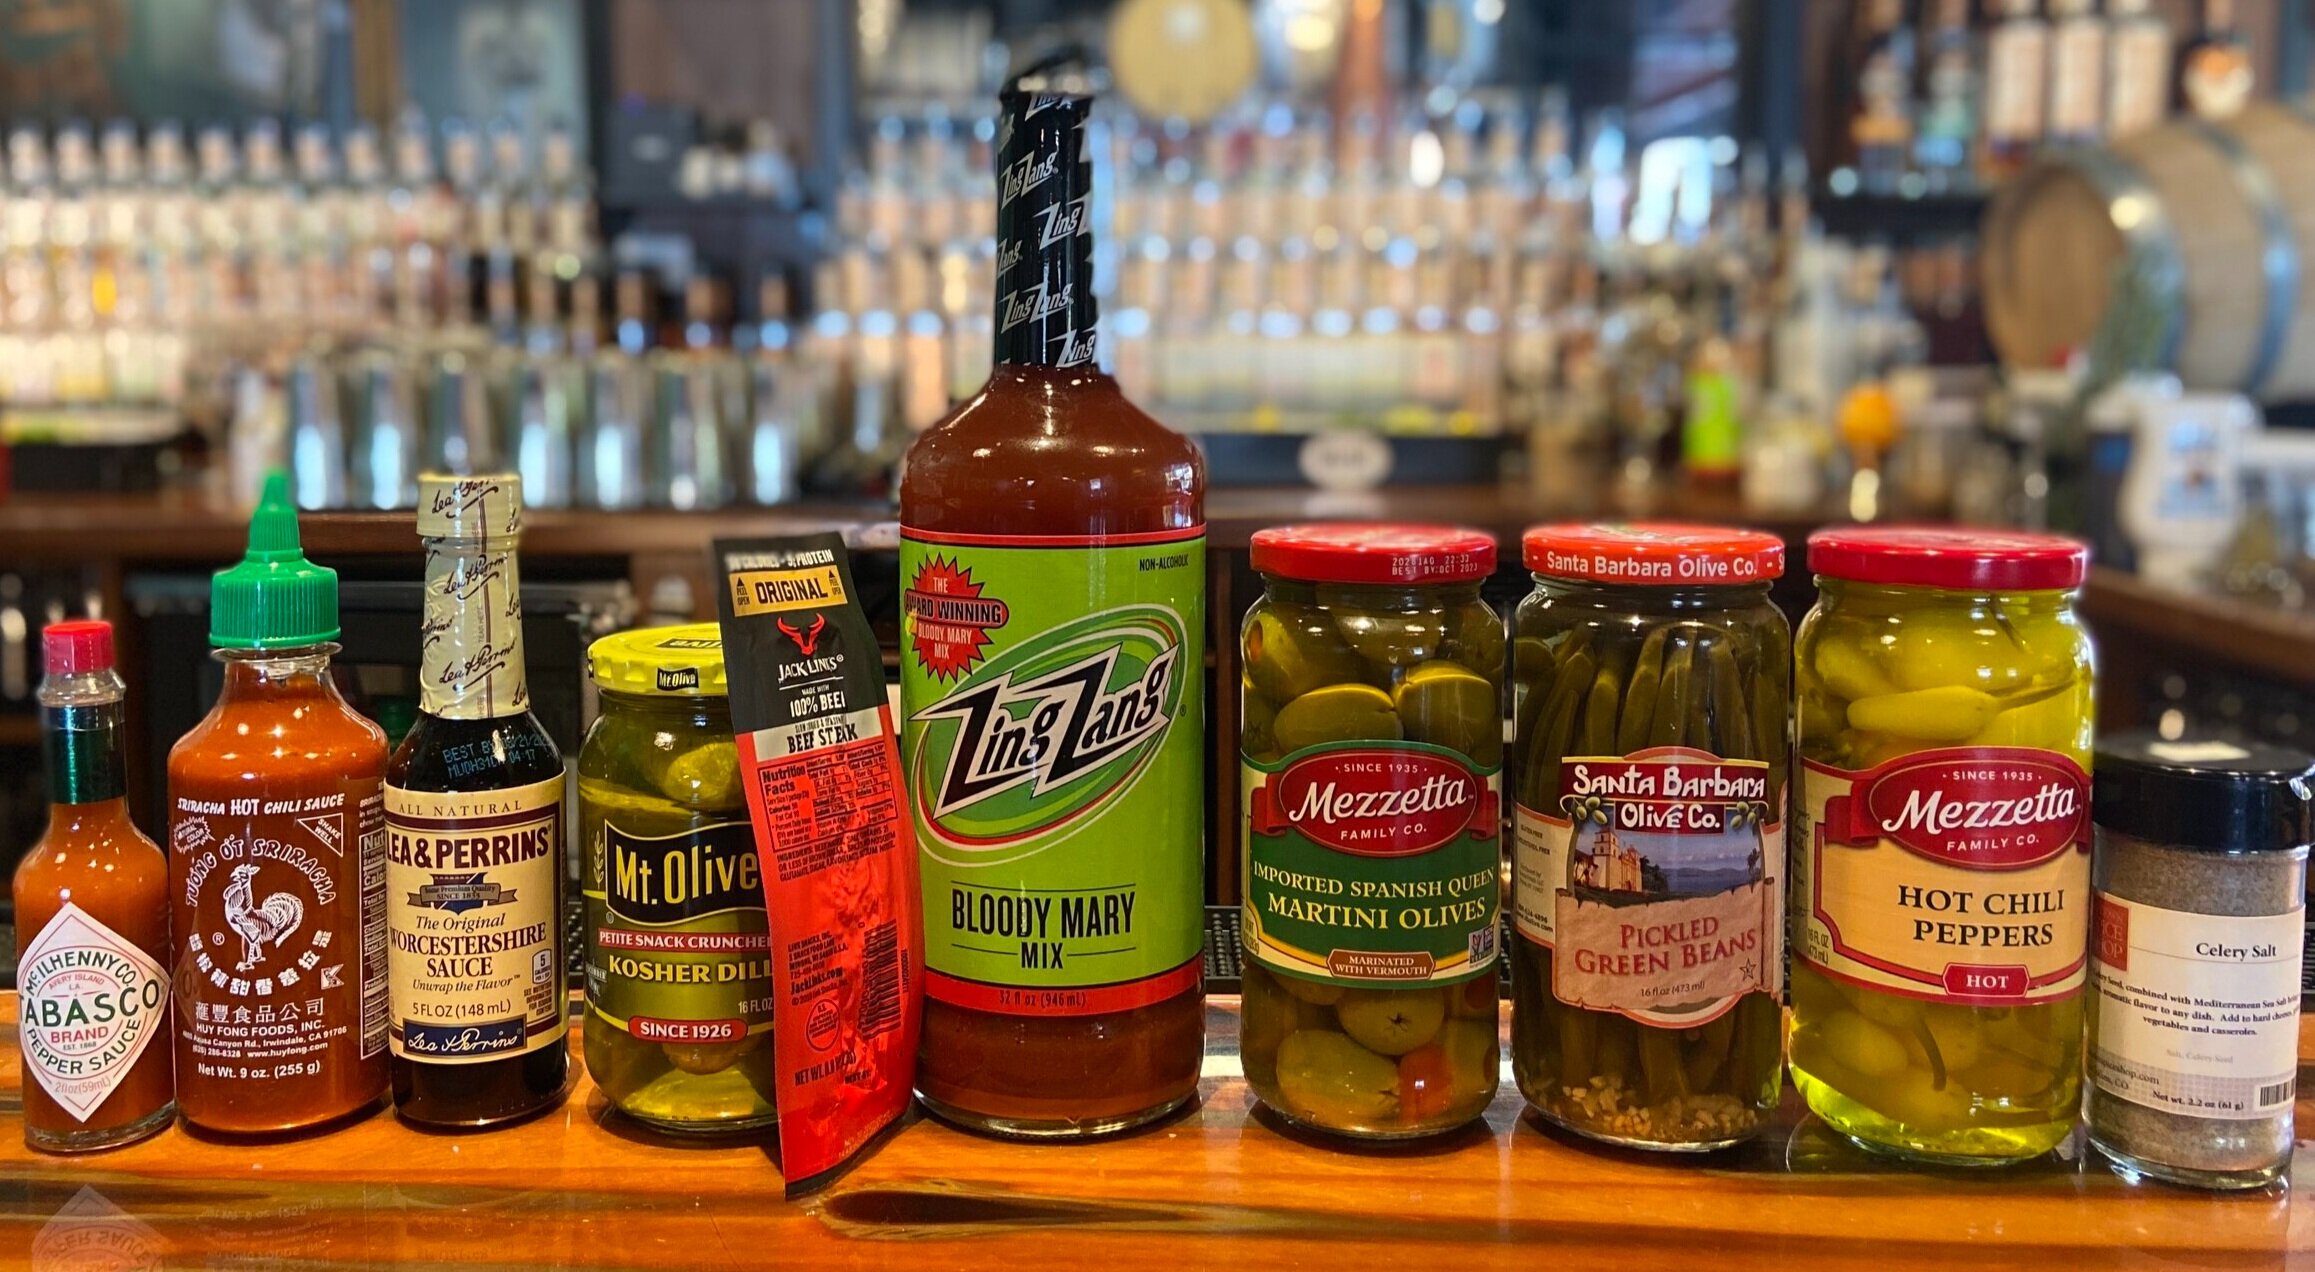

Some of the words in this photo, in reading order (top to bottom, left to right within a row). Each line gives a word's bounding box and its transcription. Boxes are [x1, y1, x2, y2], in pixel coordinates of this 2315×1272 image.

[797, 549, 834, 567] PROTEIN
[1139, 554, 1189, 571] NON-ALCOHOLIC
[1547, 550, 1589, 573] Santa
[1594, 556, 1672, 577] Barbara
[1679, 556, 1728, 578] Olive
[1733, 557, 1757, 576] Co.
[1392, 566, 1416, 576] BEST
[755, 577, 828, 605] ORIGINAL
[932, 577, 948, 593] THE
[938, 599, 1001, 624] WINNING
[917, 623, 945, 641] BLOODY
[947, 629, 973, 645] MARY
[934, 645, 950, 660] MIX
[790, 694, 819, 718] 100%
[443, 743, 475, 764] BEST
[762, 764, 806, 784] Nutrition
[1344, 764, 1382, 773] SINCE
[1389, 764, 1418, 773] 1935
[1953, 771, 1996, 781] SINCE
[2002, 771, 2033, 781] 1935
[764, 780, 796, 797] Facts
[1573, 764, 1656, 796] Santa
[1662, 766, 1765, 798] Barbara
[177, 797, 226, 816] SRIRACHA
[231, 798, 260, 817] HOT
[264, 800, 302, 815] CHILI
[303, 792, 346, 811] SAUCE
[399, 803, 424, 816] ALL
[433, 799, 522, 817] NATURAL
[1289, 773, 1467, 824] Mezzetta
[1882, 782, 2075, 835] Mezzetta
[768, 804, 791, 815] Calories
[1620, 803, 1685, 828] Olive
[1688, 804, 1721, 829] Co.
[313, 825, 334, 845] WELL
[317, 817, 342, 840] SHAKE
[1341, 827, 1396, 841] FAMILY
[1403, 823, 1427, 835] CO.
[1947, 837, 2008, 851] FAMILY
[2017, 833, 2040, 846] CO.
[252, 838, 337, 906] SRIRACHA
[615, 844, 658, 906] Mt.
[663, 844, 758, 905] Olive
[1254, 861, 1343, 895] IMPORTED
[1350, 880, 1442, 898] SPANISH
[1448, 865, 1495, 896] QUEEN
[1898, 885, 1974, 914] HOT
[1983, 889, 2065, 915] CHILI
[951, 888, 1052, 938] BLOODY
[1061, 891, 1136, 938] MARY
[1268, 892, 1388, 929] MARTINI
[1399, 896, 1486, 929] OLIVES
[416, 915, 440, 930] The
[443, 912, 506, 933] Original
[389, 922, 547, 957] WORCESTERSHIRE
[599, 930, 633, 946] PETITE
[635, 935, 685, 949] SNACK
[1620, 916, 1719, 950] PICKLED
[1913, 918, 2053, 948] PEPPERS
[540, 954, 546, 966] 5
[1021, 942, 1064, 969] MIX
[1349, 955, 1415, 966] MARINATED
[1575, 949, 1670, 977] GREEN
[1682, 928, 1757, 970] BEANS
[2196, 942, 2248, 962] Celery
[2251, 944, 2277, 958] Salt
[115, 963, 137, 987] CO.
[427, 956, 493, 979] SAUCE
[609, 954, 711, 983] KOSHER
[1335, 963, 1364, 975] WITH
[1367, 965, 1427, 976] VERMOUTH
[48, 974, 73, 990] AVERY
[74, 973, 105, 986] ISLAND
[413, 979, 454, 995] Unwrap
[455, 979, 473, 992] the
[1640, 987, 1651, 997] 16
[1659, 985, 1671, 996] oz
[1671, 983, 1691, 996] (473
[1965, 974, 2010, 989] HOT
[21, 979, 160, 1028] ABASCO
[738, 1000, 748, 1014] 16
[750, 999, 761, 1013] FL
[761, 998, 773, 1011] OZ
[1024, 992, 1036, 1006] oz
[1040, 991, 1065, 1008] (946
[2126, 984, 2168, 1002] combined
[2170, 990, 2191, 1005] with
[2194, 997, 2261, 1010] Mediterranean
[413, 1003, 418, 1016] 5
[421, 1003, 432, 1016] FL
[434, 1004, 453, 1018] OZ
[456, 1003, 484, 1019] (148
[487, 999, 511, 1015] mL)
[2133, 998, 2158, 1013] flavor
[2160, 1004, 2170, 1015] to
[2172, 1008, 2189, 1020] any
[2191, 1009, 2215, 1022] dish.
[2220, 1013, 2240, 1023] Add
[2241, 1015, 2251, 1023] to
[51, 1026, 109, 1044] BRAND
[197, 1023, 214, 1034] HUY
[217, 1026, 248, 1037] FONG
[252, 1024, 297, 1037] FOODS,
[301, 1019, 325, 1031] INC.
[640, 1021, 688, 1038] SINCE
[692, 1023, 732, 1038] 1926
[2142, 1014, 2189, 1032] vegetables
[2191, 1023, 2210, 1034] and
[2212, 1027, 2258, 1036] casseroles.
[27, 1028, 83, 1074] PEPPER
[89, 1019, 141, 1071] SAUCE
[63, 1043, 77, 1051] EST.
[80, 1041, 97, 1050] 1868
[213, 1038, 242, 1049] Canyon
[309, 1031, 322, 1041] CA
[408, 1031, 438, 1051] Lea
[456, 1027, 518, 1051] Perrins
[247, 1041, 329, 1058] www.huyfong.com
[198, 1062, 215, 1076] Net
[217, 1066, 237, 1078] Wt.
[240, 1067, 248, 1079] 9
[251, 1069, 270, 1078] oz.
[274, 1062, 303, 1079] (255
[306, 1060, 321, 1074] g)
[2114, 1079, 2129, 1090] CO
[2153, 1089, 2169, 1103] Net
[2187, 1098, 2203, 1107] 2.2
[2218, 1100, 2232, 1110] (61
